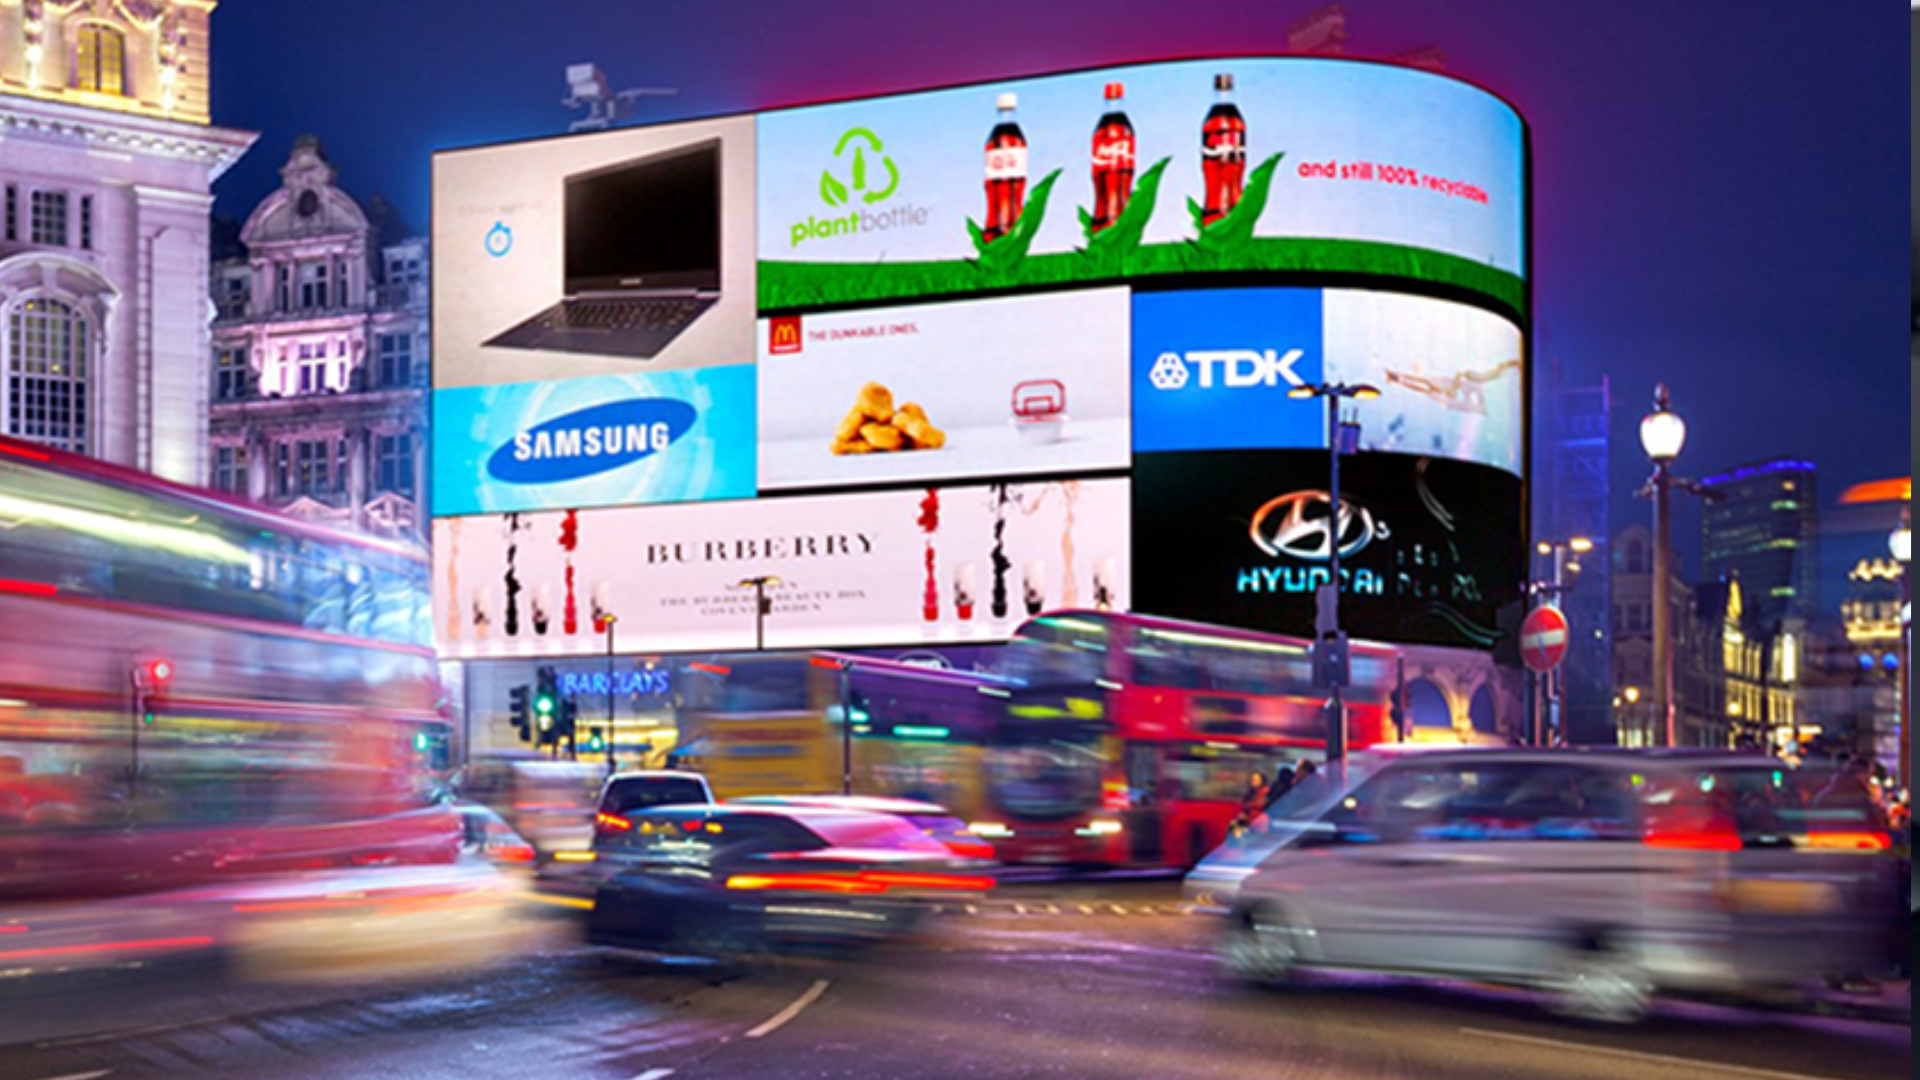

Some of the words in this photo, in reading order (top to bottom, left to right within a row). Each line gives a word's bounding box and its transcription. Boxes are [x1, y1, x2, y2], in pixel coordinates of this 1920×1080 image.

[1298, 160, 1336, 179] and
[1341, 161, 1372, 181] still
[1377, 163, 1418, 187] 100%
[1184, 349, 1304, 388] TDK
[514, 422, 670, 462] SAMSUNG
[648, 532, 880, 565] BURBERRY
